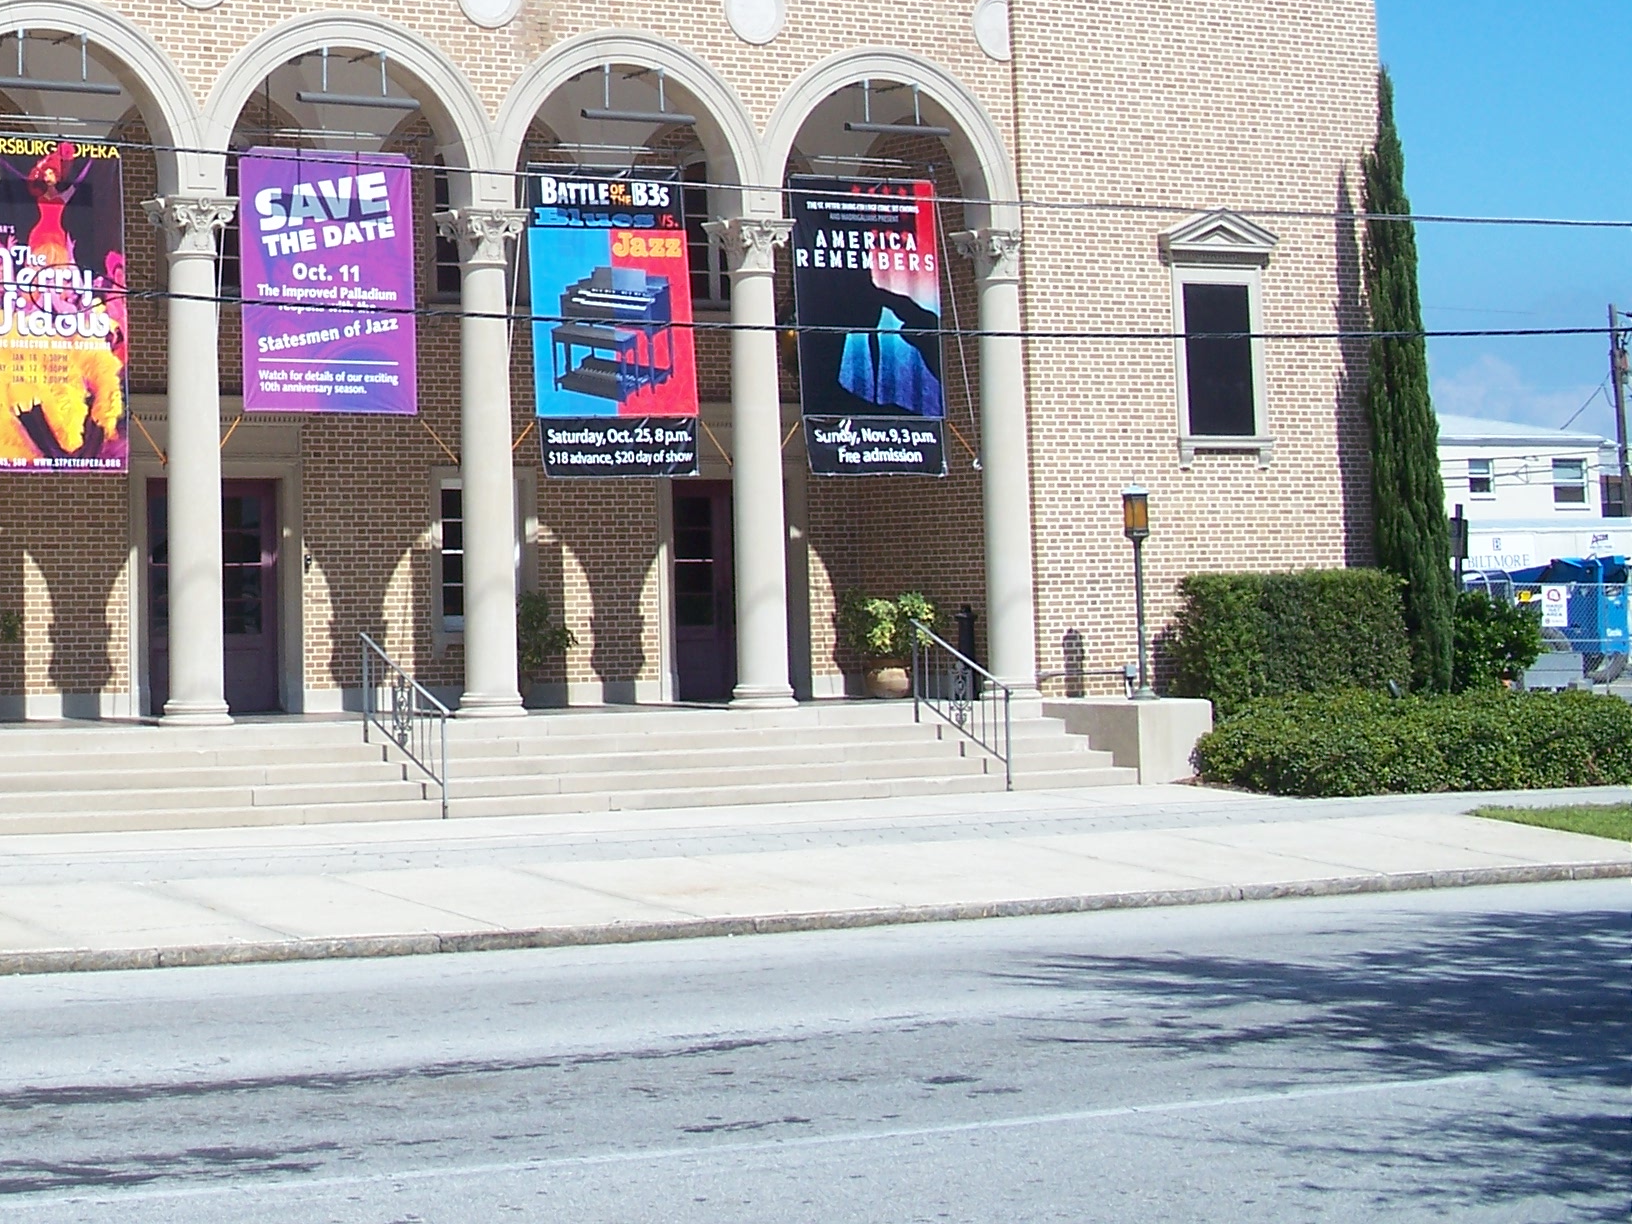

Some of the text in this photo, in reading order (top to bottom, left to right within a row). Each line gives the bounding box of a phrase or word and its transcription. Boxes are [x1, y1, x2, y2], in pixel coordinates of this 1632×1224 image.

[610, 183, 626, 195] OF
[254, 170, 391, 232] SAVE
[610, 194, 632, 206] THE
[534, 206, 656, 228] Blues
[261, 215, 396, 258] THE DATE
[612, 232, 683, 258] Jazz
[816, 229, 917, 251] AMERICA
[10, 245, 48, 266] The
[796, 248, 935, 272] REMEMBERS
[292, 262, 360, 282] Oct. 11
[257, 283, 397, 301] The improved Palladium
[257, 317, 399, 354] Statesmen of Jazz
[258, 369, 399, 386] Watch for details of our exciting
[259, 381, 367, 396] 10th anniversary season.
[547, 428, 693, 447] Saturday, Oct. 25, 8 p.m.
[861, 428, 889, 443] Nov.
[911, 431, 937, 446] p.m.
[548, 450, 694, 466] $18 advance, $20 day of show
[862, 447, 923, 463] admission
[1468, 553, 1530, 568] BILTMORE
